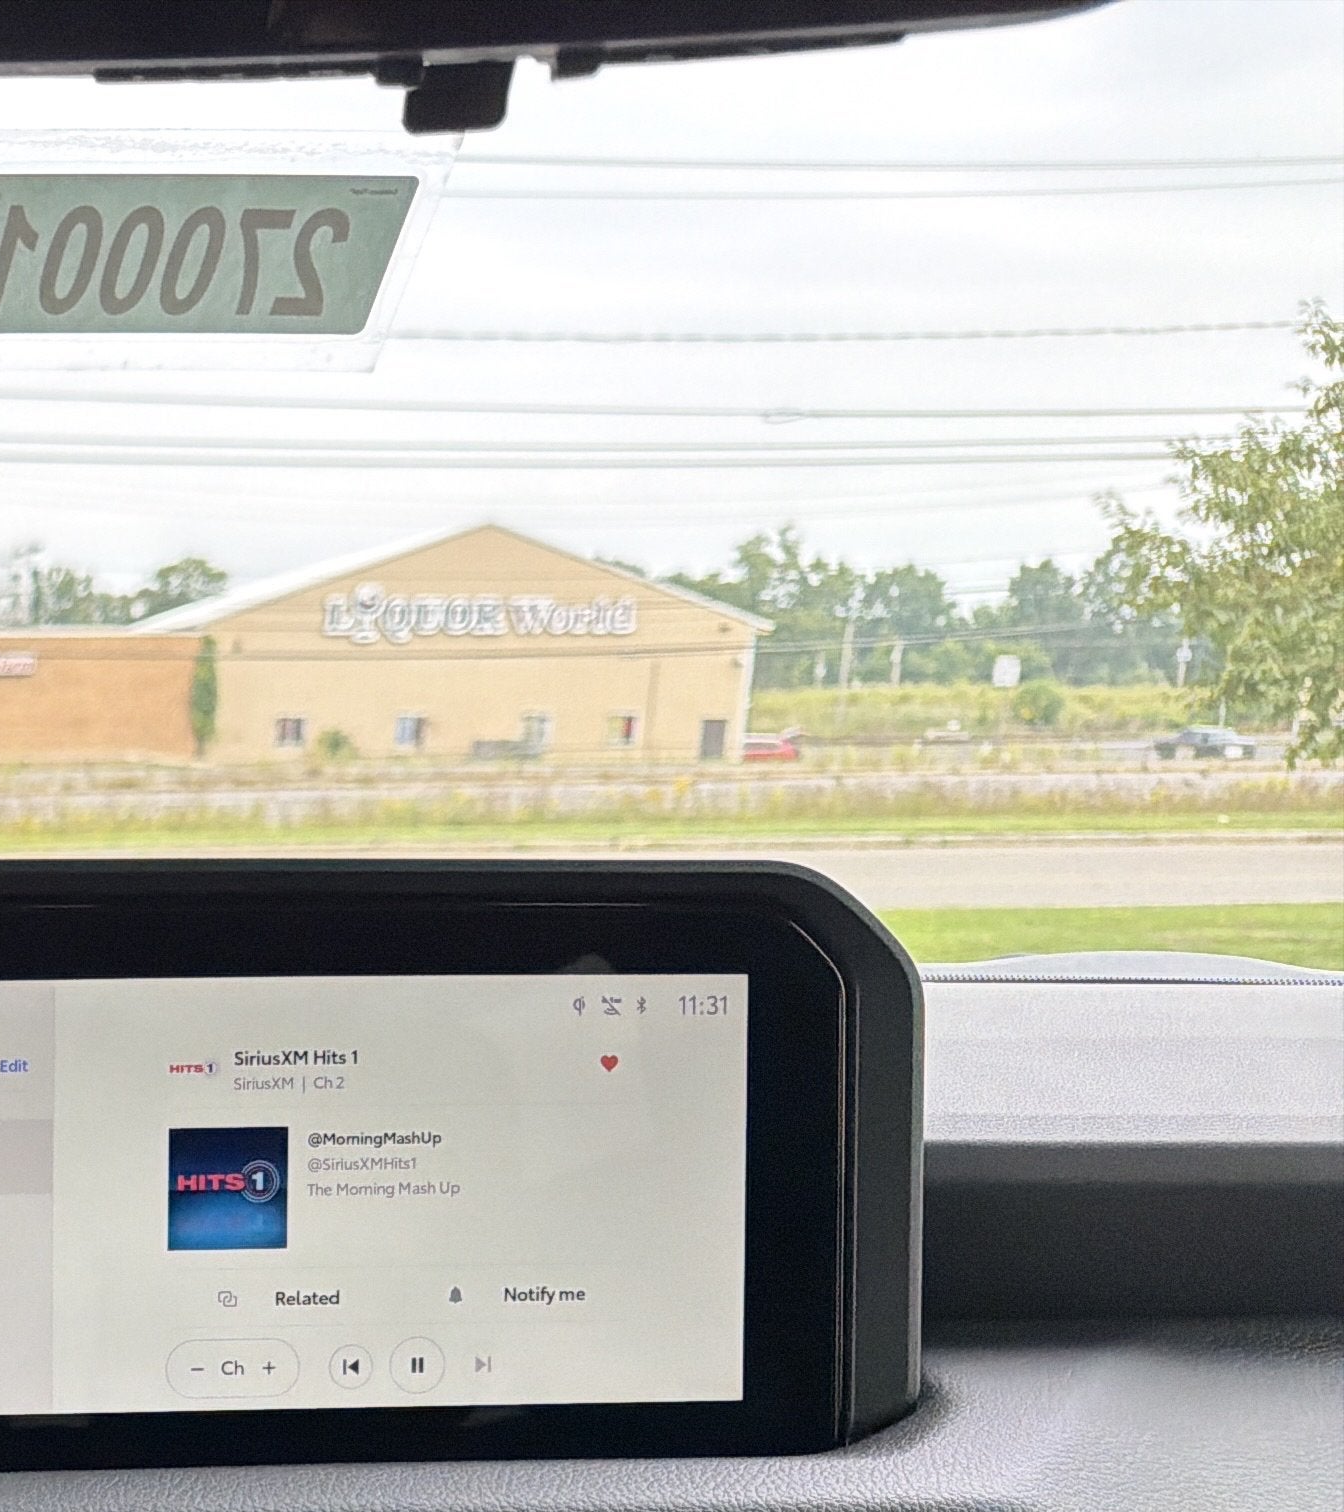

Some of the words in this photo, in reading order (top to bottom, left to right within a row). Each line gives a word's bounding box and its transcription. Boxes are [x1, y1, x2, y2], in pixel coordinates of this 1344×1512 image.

[679, 996, 728, 1015] 11:31
[0, 1059, 29, 1073] Edit
[234, 1051, 309, 1066] SiriusXM
[314, 1050, 347, 1065] Hits
[351, 1050, 358, 1064] 1
[170, 1064, 204, 1073] HITS
[233, 1076, 294, 1091] SiriusXM
[314, 1076, 334, 1090] Ch
[336, 1076, 344, 1089] 2
[308, 1131, 442, 1149] @MorningMashUp
[307, 1157, 417, 1172] @SiriusXMHits1
[177, 1173, 246, 1192] HITS
[251, 1171, 264, 1191] 1
[307, 1182, 333, 1197] The
[336, 1182, 394, 1200] Morning
[399, 1181, 435, 1195] Mash
[439, 1181, 461, 1198] Up
[275, 1290, 340, 1306] Related
[504, 1287, 556, 1304] Notify
[560, 1290, 586, 1301] me
[221, 1361, 244, 1375] Ch
